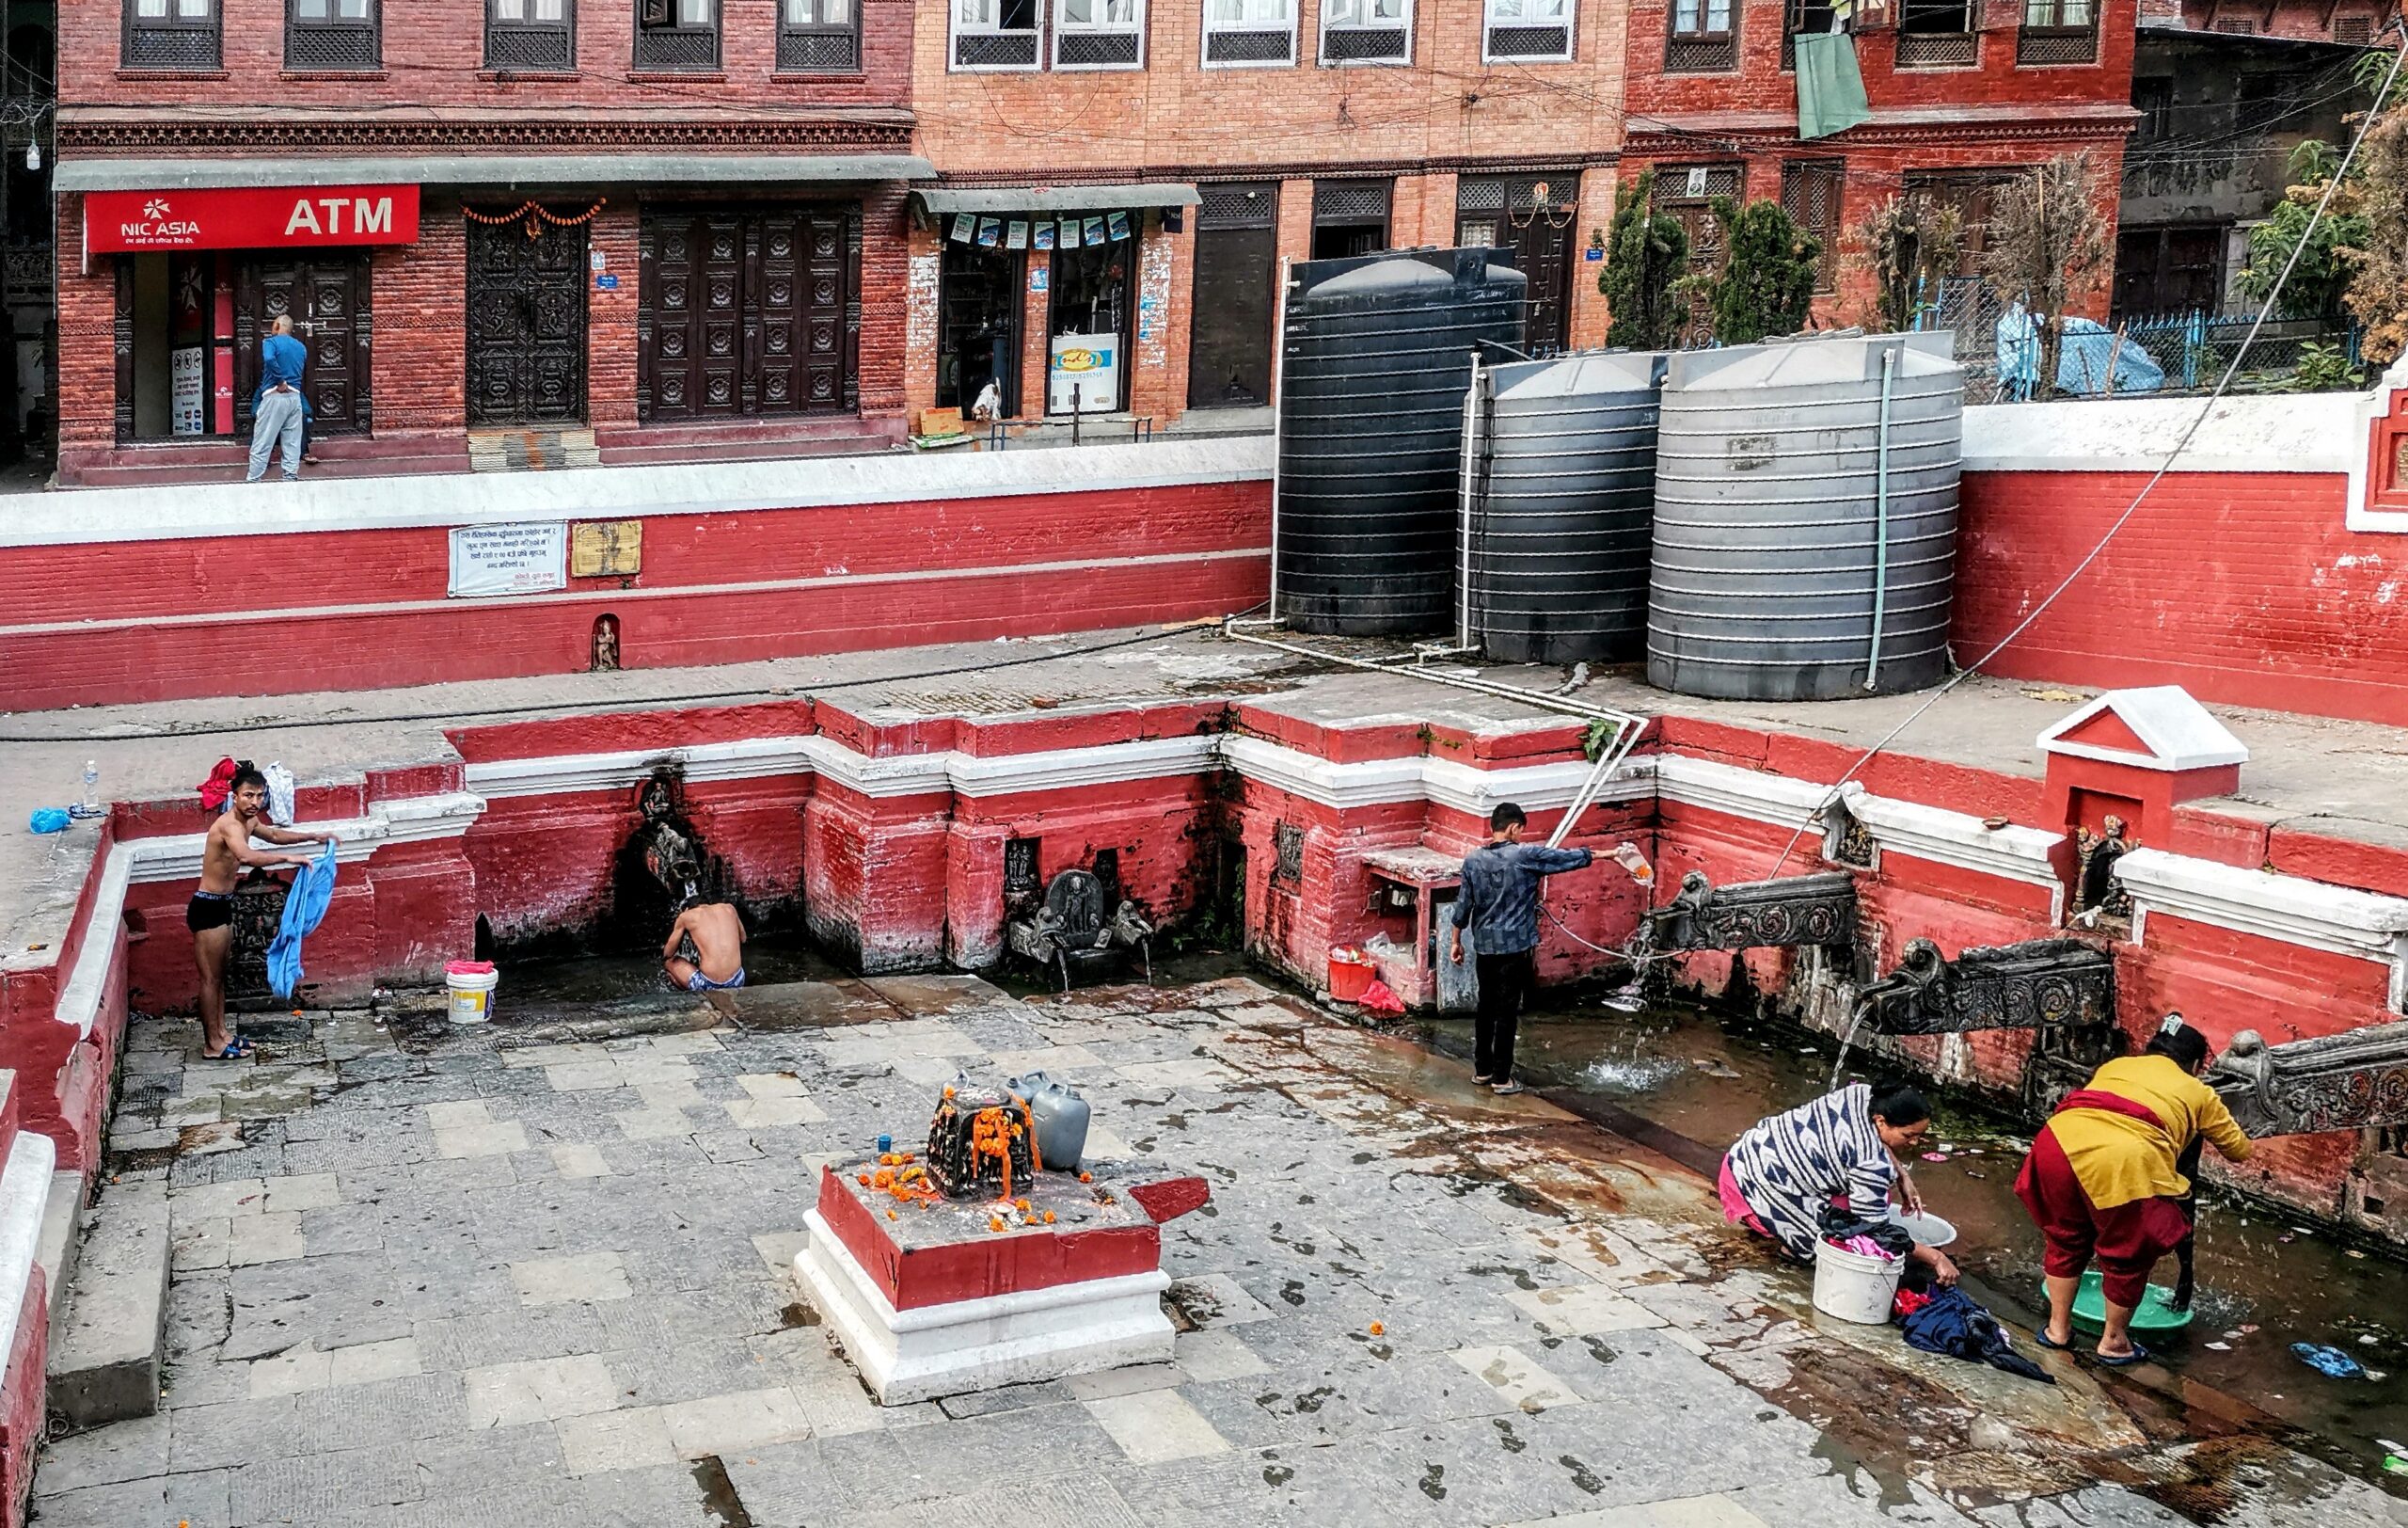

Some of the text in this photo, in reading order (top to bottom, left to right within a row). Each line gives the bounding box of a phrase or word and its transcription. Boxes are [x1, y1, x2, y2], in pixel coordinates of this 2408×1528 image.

[120, 221, 200, 237] NIC ASIA
[284, 197, 392, 235] ATM
